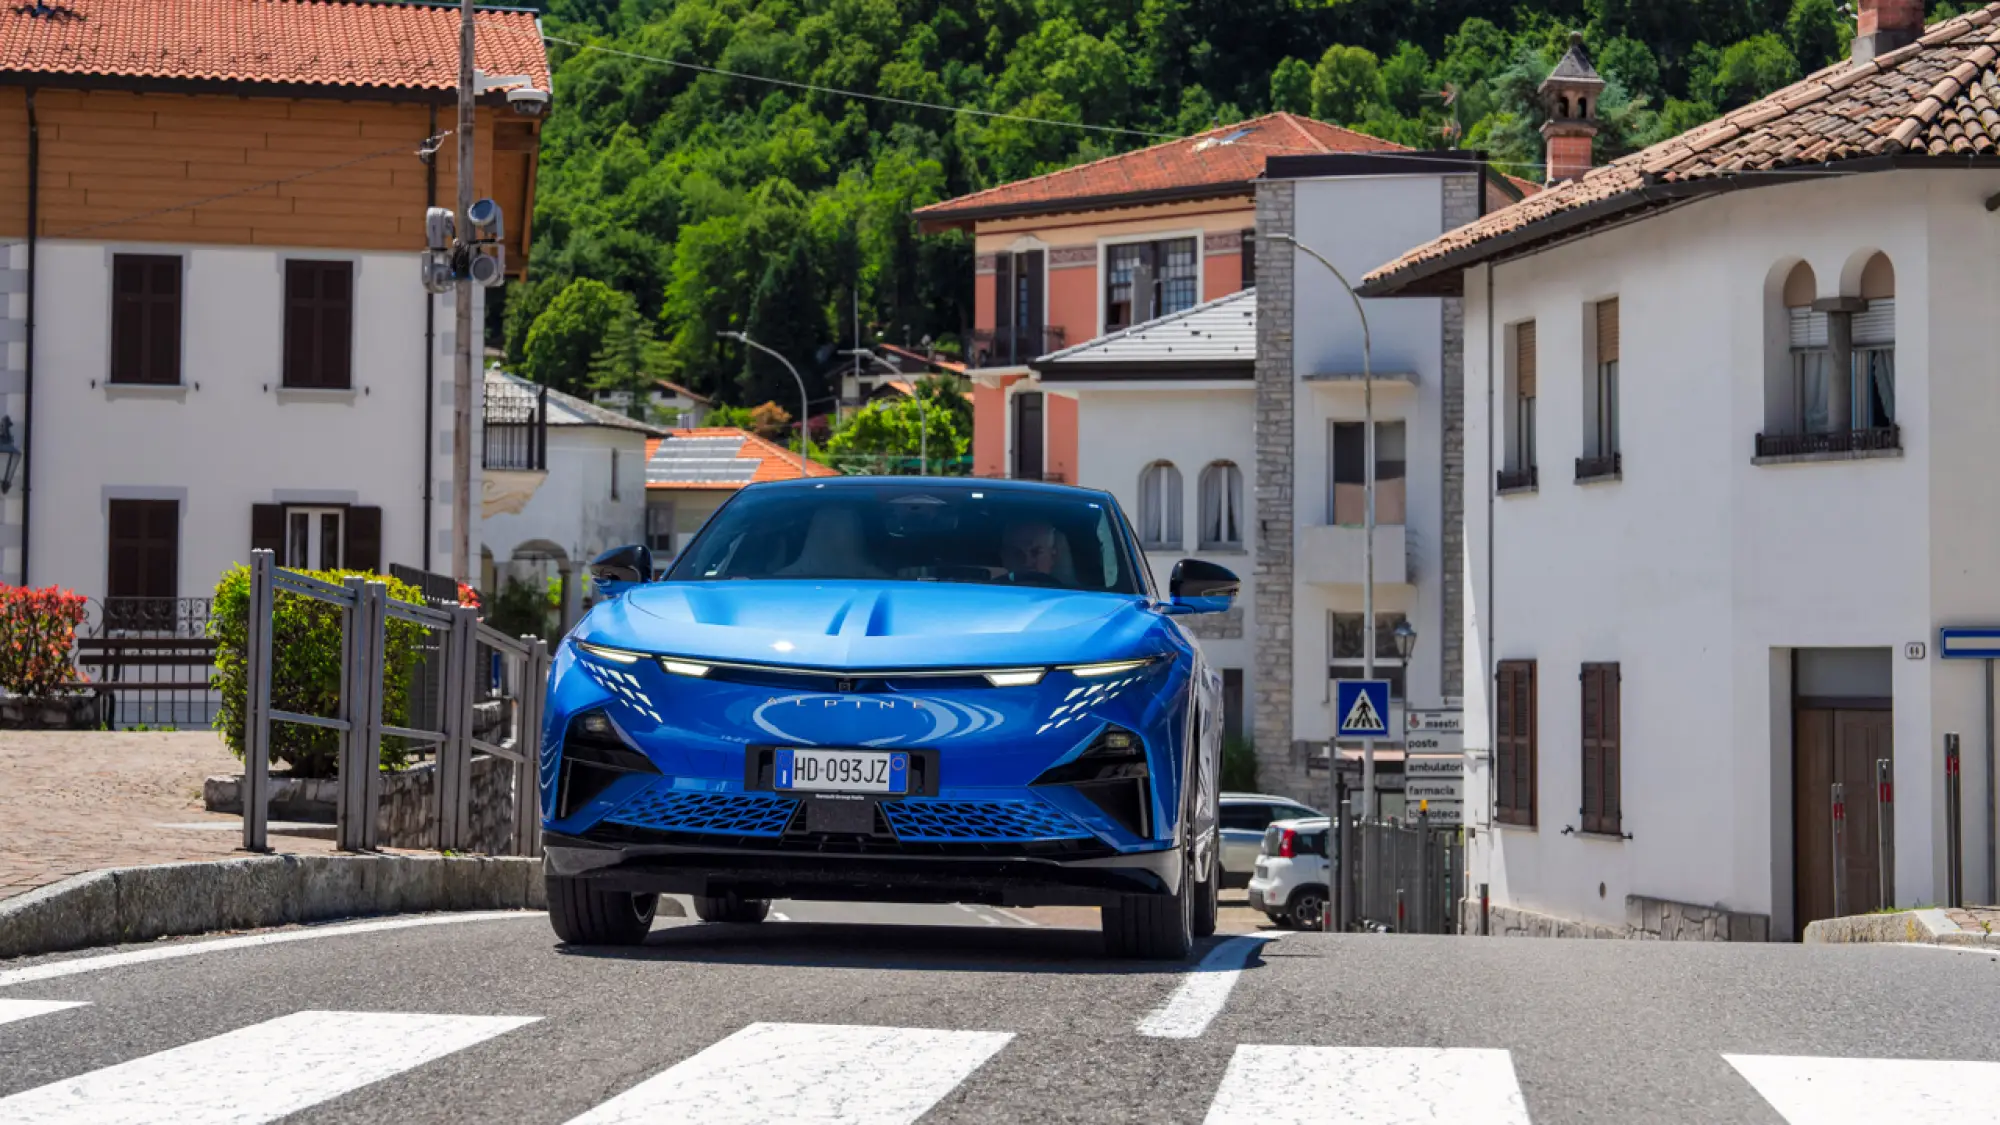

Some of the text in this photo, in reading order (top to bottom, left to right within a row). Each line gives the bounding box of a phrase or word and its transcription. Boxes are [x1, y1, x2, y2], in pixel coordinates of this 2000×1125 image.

[767, 697, 926, 709] ALPINE
[1425, 718, 1459, 728] maestri
[1408, 739, 1438, 749] poste
[1408, 786, 1455, 796] farmacia
